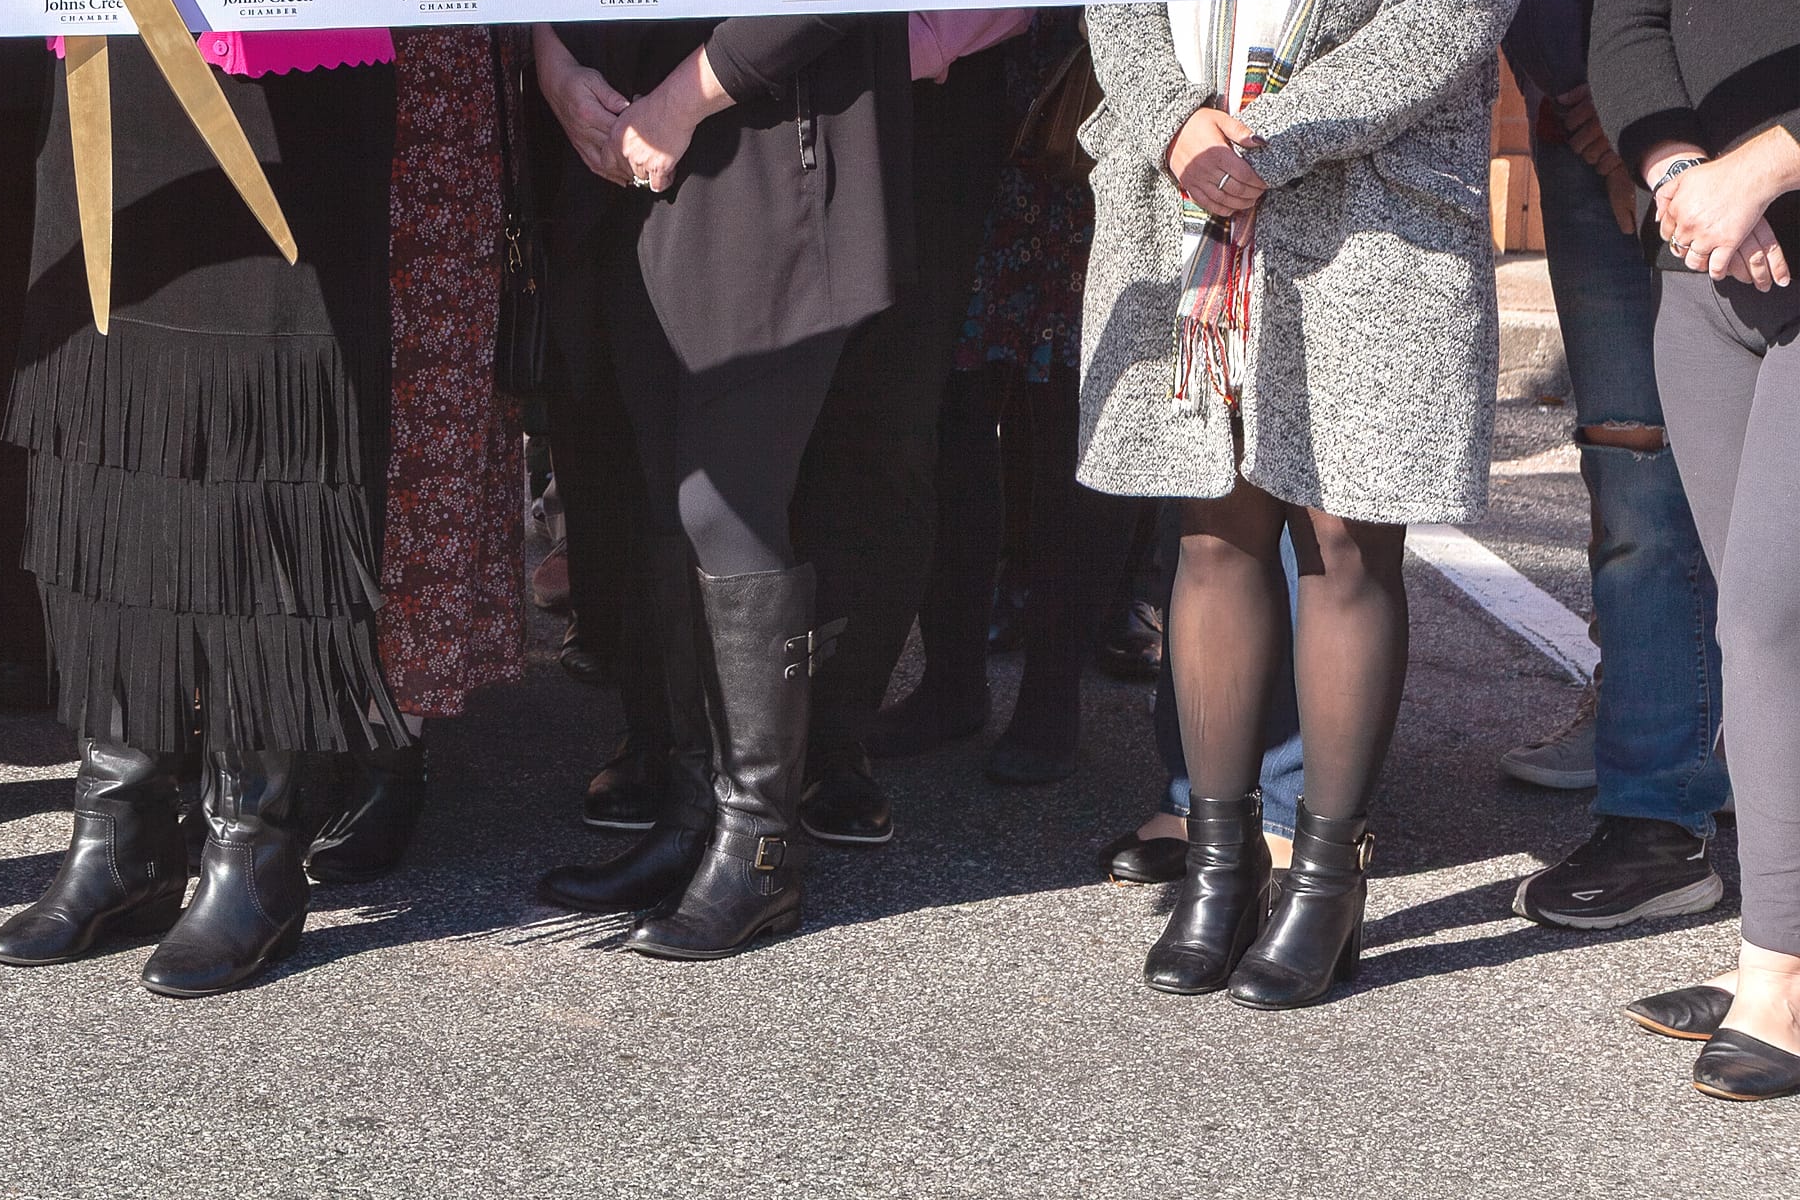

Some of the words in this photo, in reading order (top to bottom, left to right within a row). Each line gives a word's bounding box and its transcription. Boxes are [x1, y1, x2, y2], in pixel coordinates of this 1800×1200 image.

[419, 2, 478, 11] CHAMBER
[239, 8, 297, 16] CHAMBER
[60, 14, 117, 22] CHAMBER
